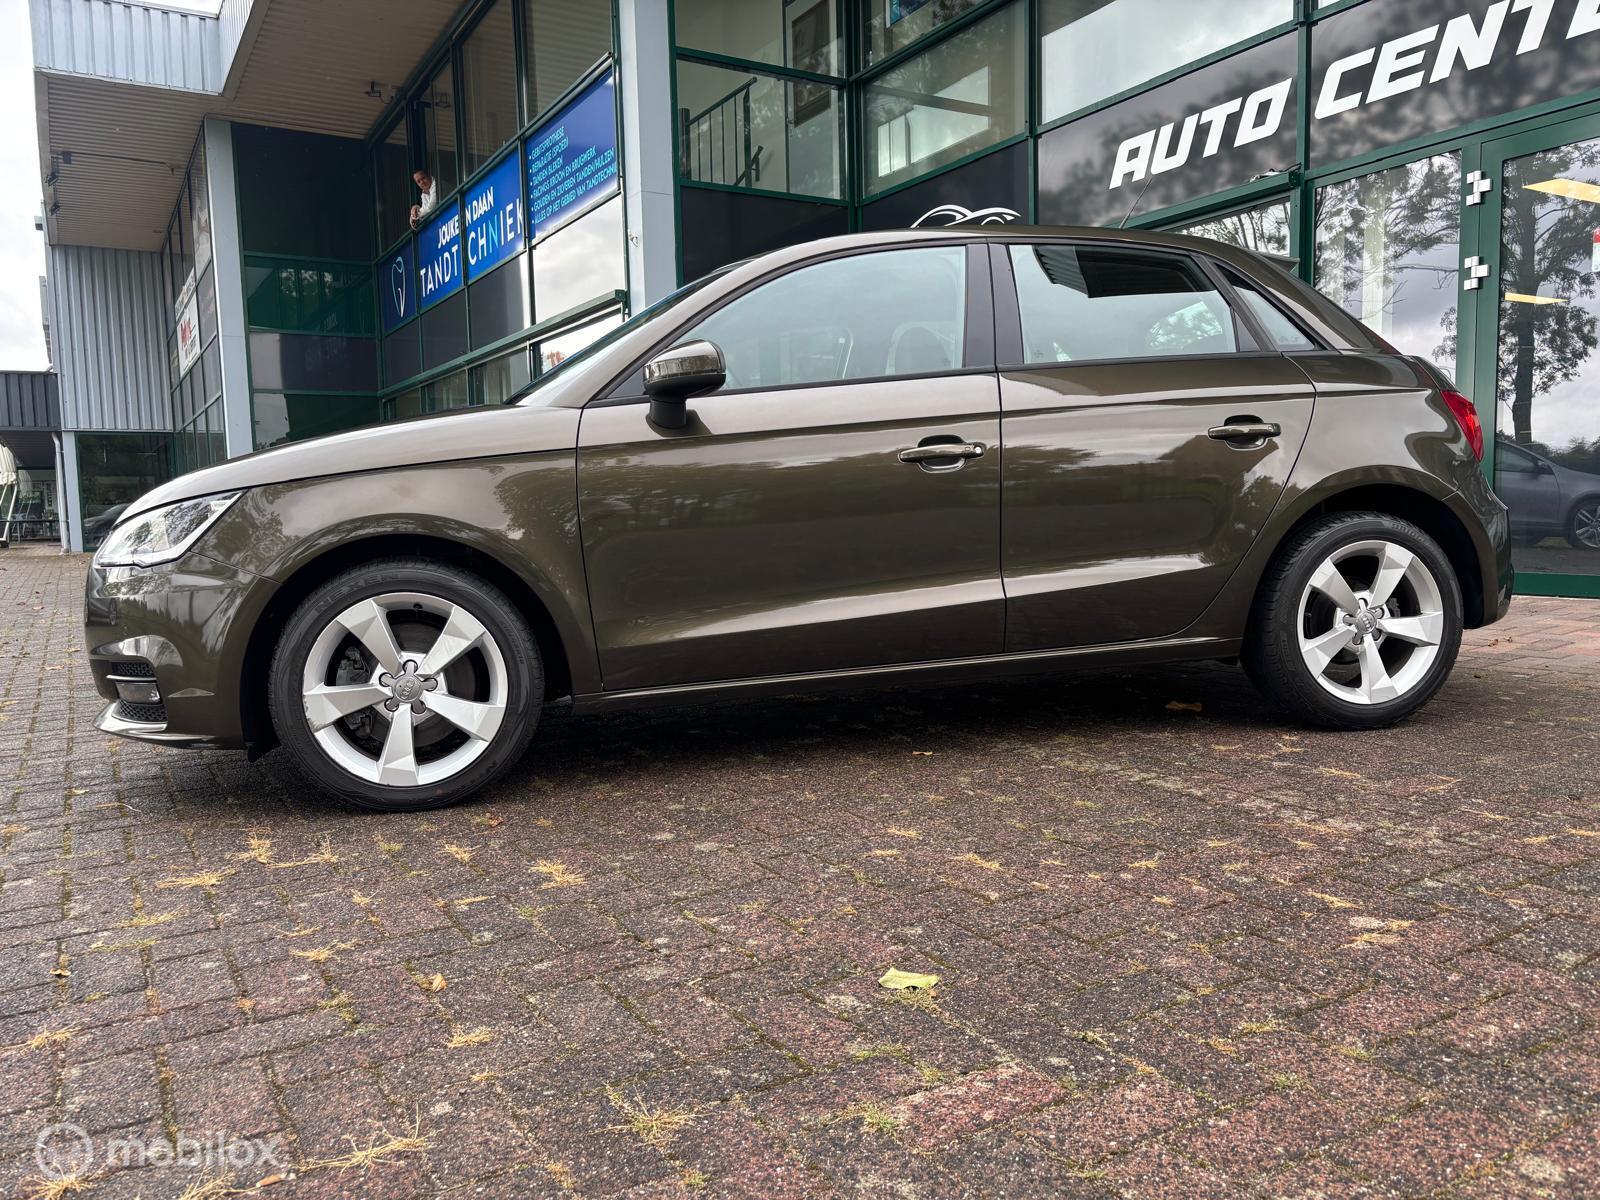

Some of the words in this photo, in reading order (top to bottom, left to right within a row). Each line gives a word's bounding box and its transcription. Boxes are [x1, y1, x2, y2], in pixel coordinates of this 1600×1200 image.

[1109, 77, 1292, 189] AUTO
[1314, 0, 1600, 120] CENT
[532, 149, 552, 173] REPARATIE
[438, 214, 460, 249] JOUKE
[472, 186, 494, 221] DAAN
[534, 208, 546, 225] ALLES
[546, 204, 553, 217] OP
[552, 199, 561, 213] HET
[561, 190, 577, 207] GEBIED
[577, 183, 586, 197] VAN
